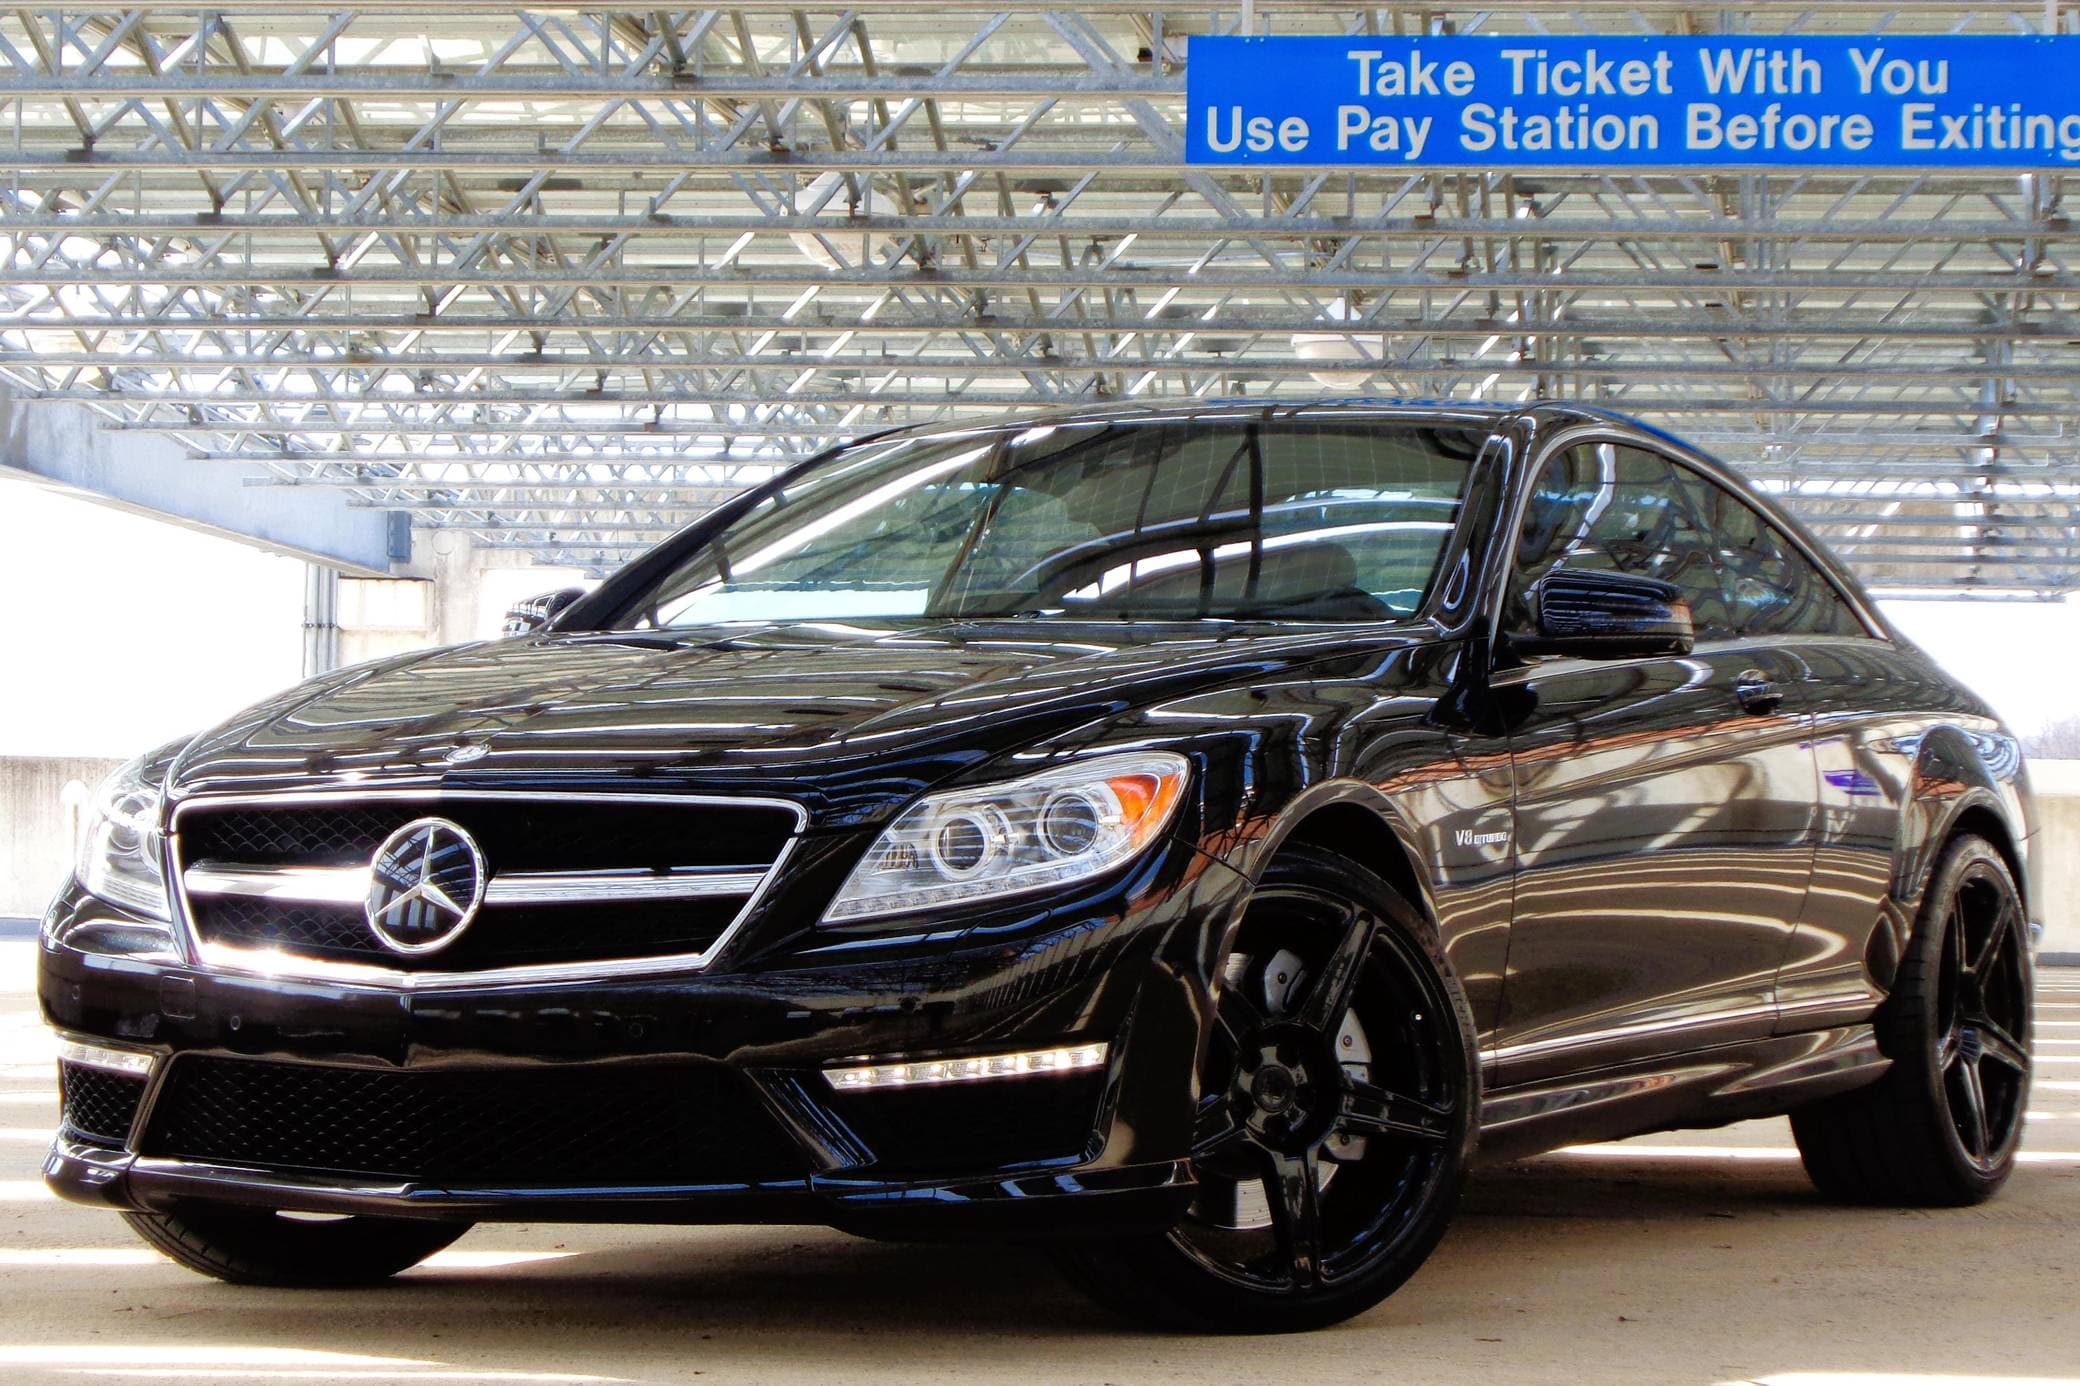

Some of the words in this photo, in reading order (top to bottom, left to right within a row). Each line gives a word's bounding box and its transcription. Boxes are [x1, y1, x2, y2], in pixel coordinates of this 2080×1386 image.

[1346, 50, 1476, 97] Take
[1500, 49, 1674, 96] Ticket
[1698, 48, 1822, 95] With
[1848, 48, 1949, 96] You
[1206, 105, 1310, 152] Use
[1336, 104, 1434, 160] Pay
[1460, 102, 1659, 151] Station
[1686, 102, 1875, 151] Before
[1902, 103, 2080, 160] Exiting
[1456, 829, 1473, 846] V8
